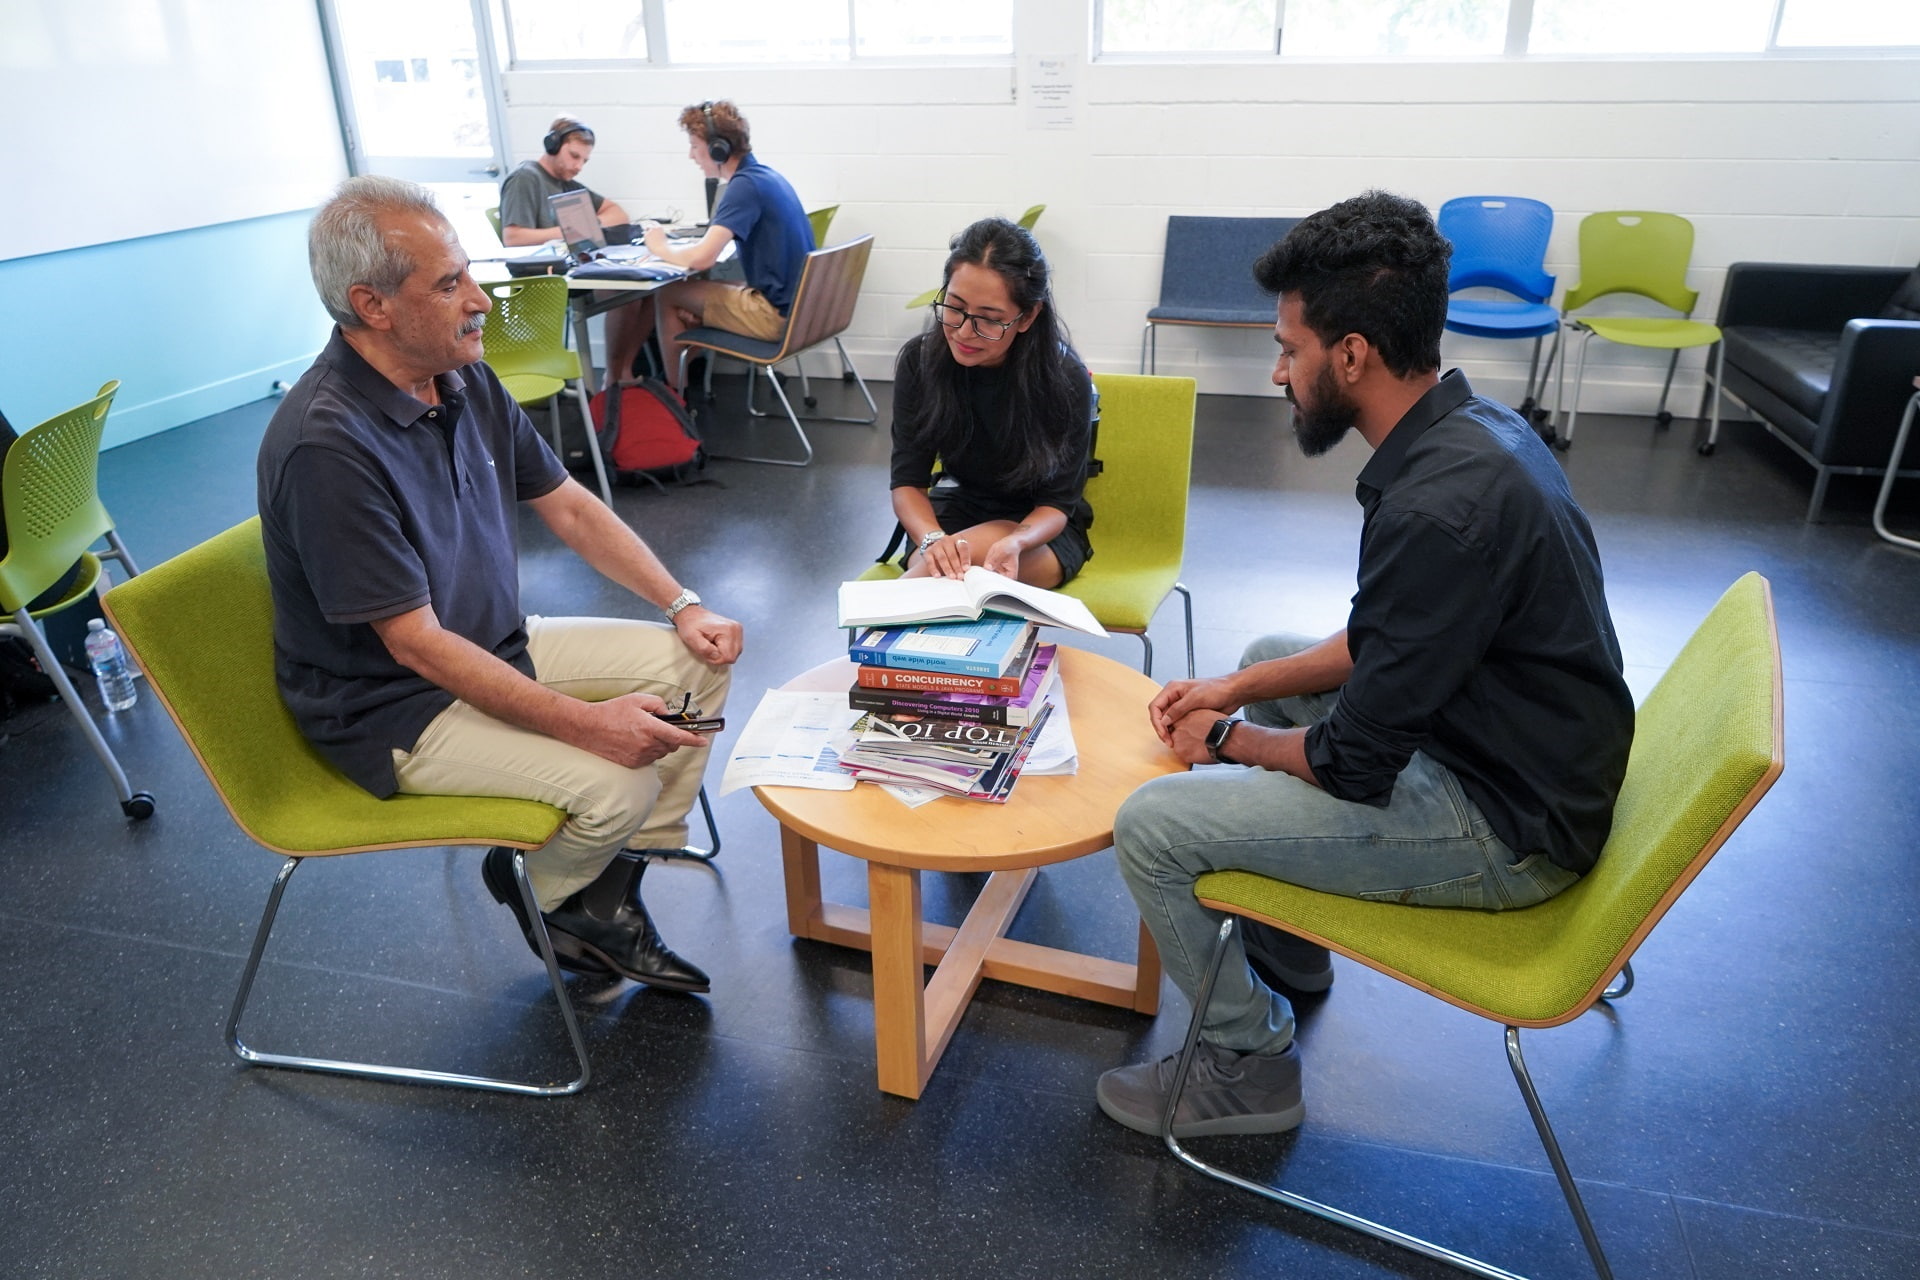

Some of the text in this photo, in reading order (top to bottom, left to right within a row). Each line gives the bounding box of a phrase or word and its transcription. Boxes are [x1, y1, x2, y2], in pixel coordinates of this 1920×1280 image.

[908, 656, 923, 664] wide
[926, 657, 946, 666] world
[895, 675, 984, 688] CONCURRENCY
[892, 700, 928, 709] Discovering
[929, 703, 963, 712] Computers
[890, 722, 1011, 744] TOP 10
